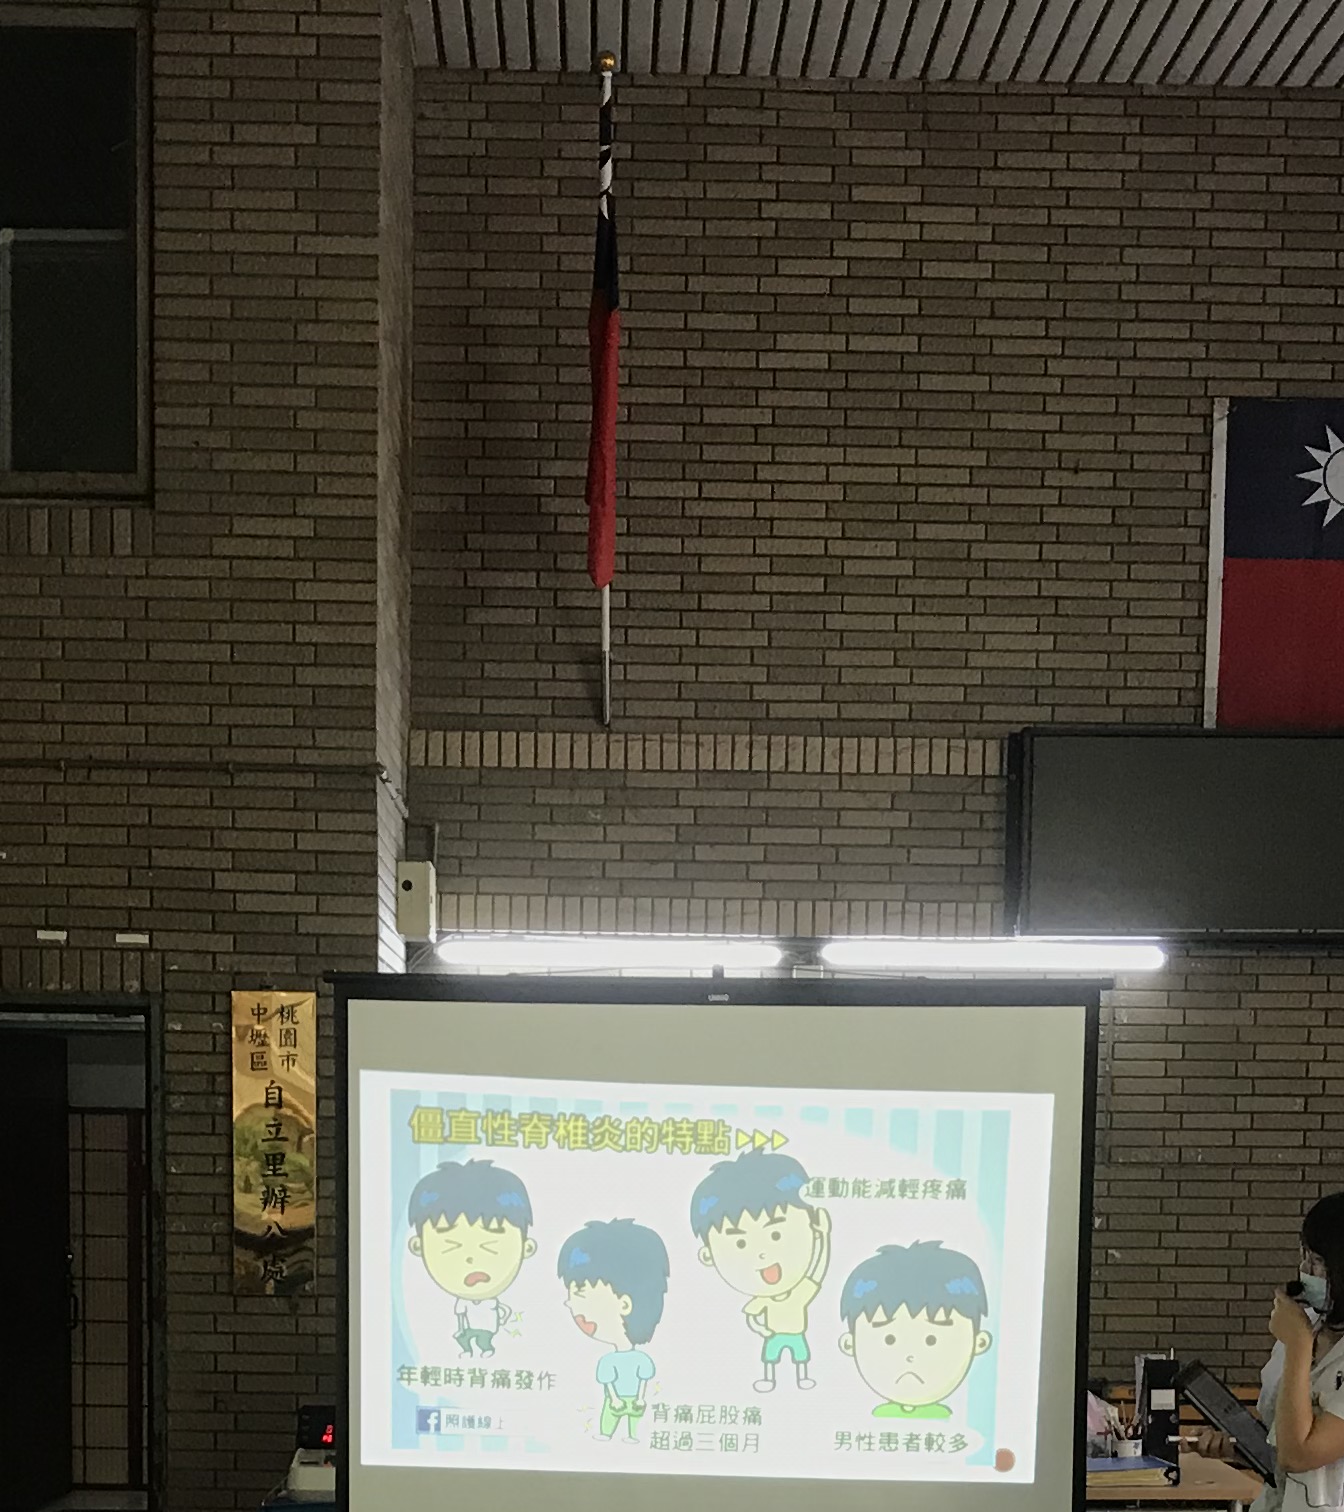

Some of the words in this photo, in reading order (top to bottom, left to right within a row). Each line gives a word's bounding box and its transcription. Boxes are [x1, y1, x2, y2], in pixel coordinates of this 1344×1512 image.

[247, 1003, 271, 1072] 中壢區
[277, 1003, 300, 1073] 桃園市
[408, 1106, 732, 1156] 僵直性脊椎炎的特點
[259, 1080, 292, 1283] 自立里辦公處
[804, 1175, 968, 1202] 運動能減輕疼痛
[396, 1362, 558, 1392] 年輕時背痛發作
[650, 1403, 763, 1428] 背痛屁股痛
[649, 1429, 761, 1455] 超過三個月
[833, 1430, 970, 1455] 男性患者較多
